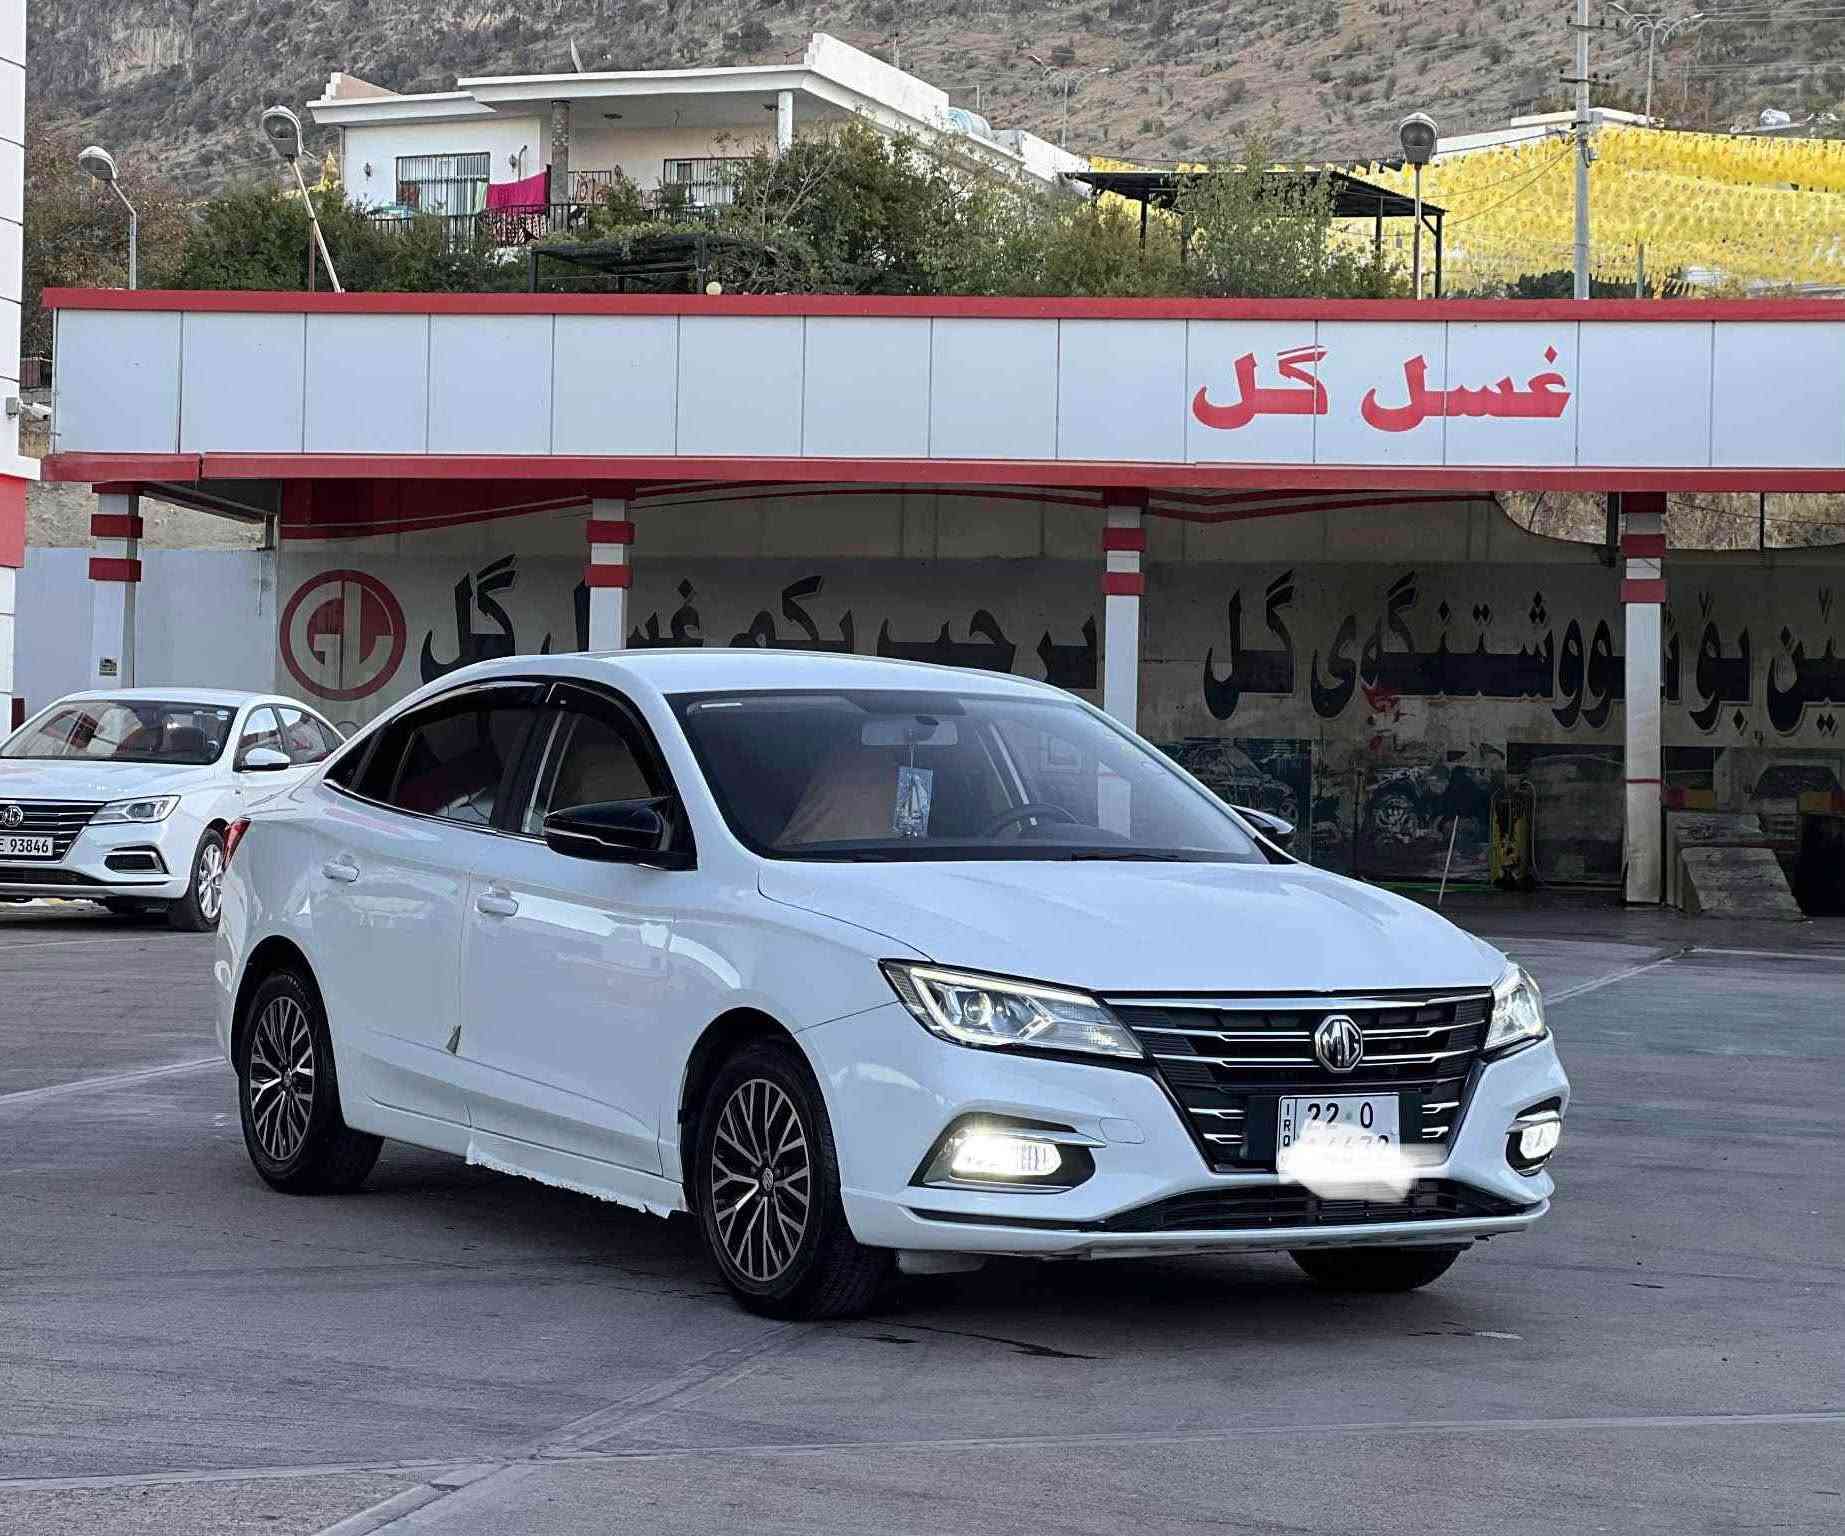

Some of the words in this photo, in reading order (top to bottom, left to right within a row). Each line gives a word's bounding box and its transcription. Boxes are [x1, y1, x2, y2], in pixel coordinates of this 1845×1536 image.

[1193, 345, 1328, 429] گل
[1361, 345, 1571, 431] غسل
[1204, 569, 1296, 720] گل
[10, 839, 49, 853] 93846
[1320, 1019, 1360, 1068] MG
